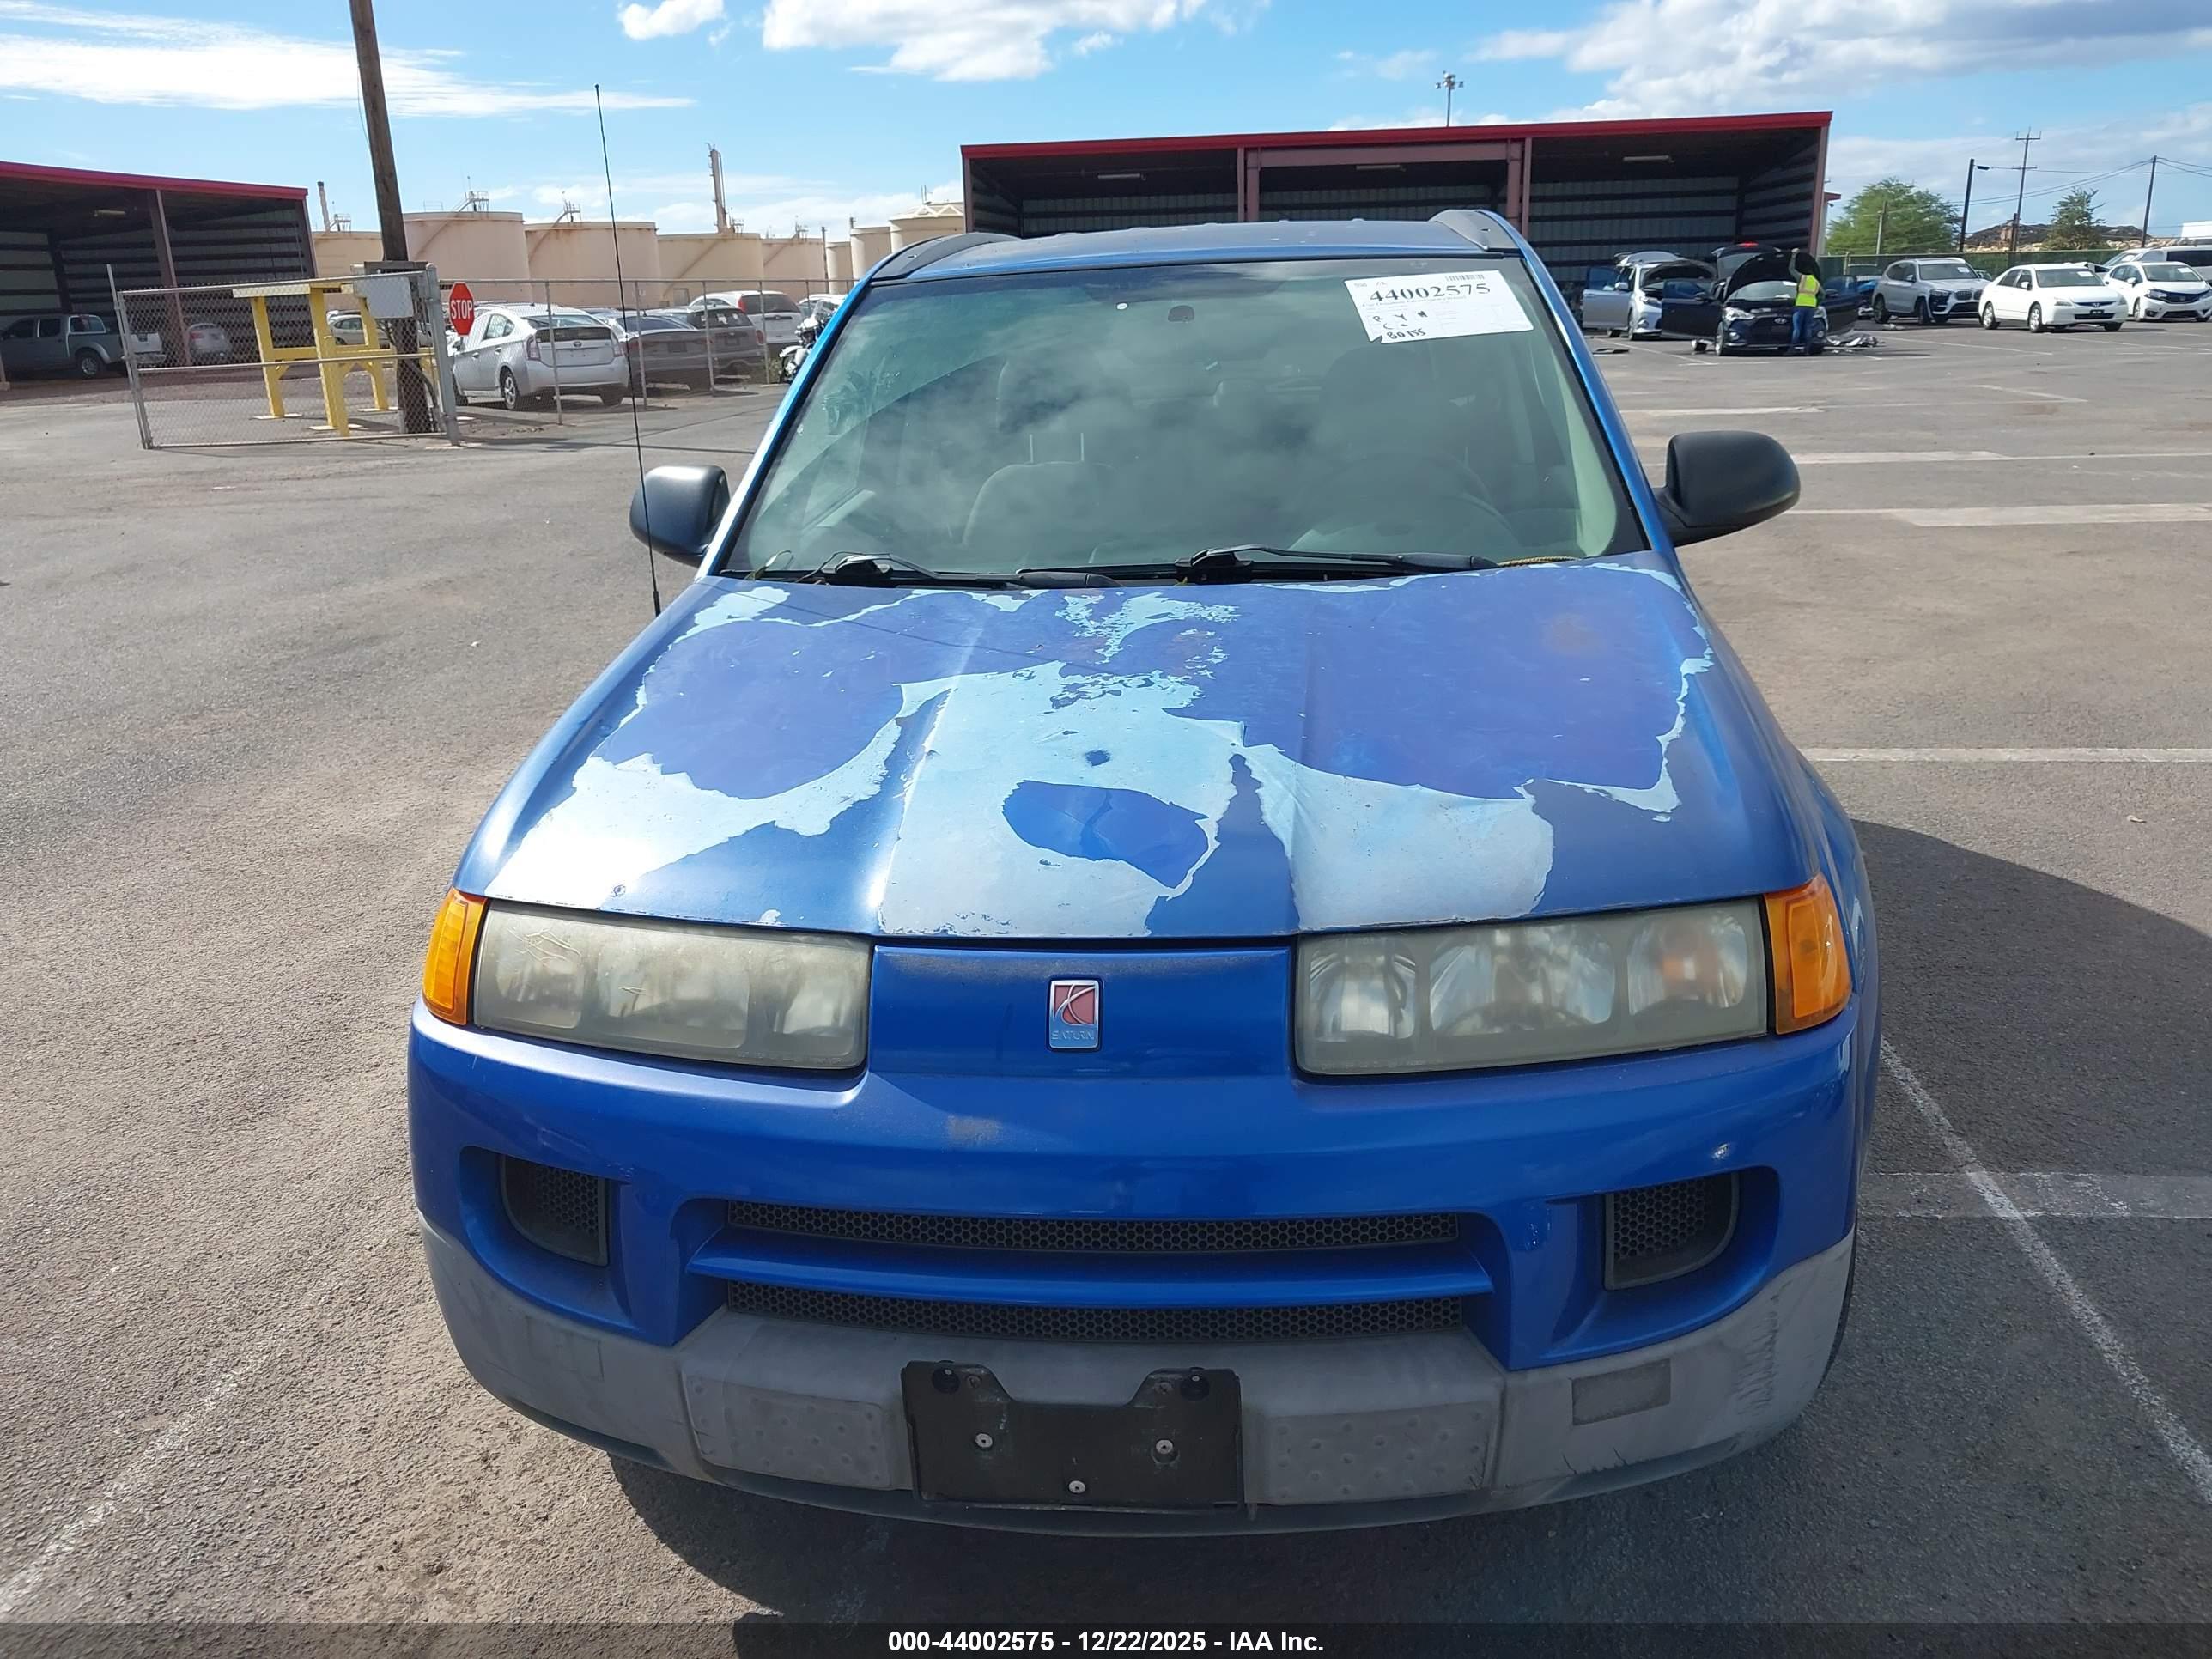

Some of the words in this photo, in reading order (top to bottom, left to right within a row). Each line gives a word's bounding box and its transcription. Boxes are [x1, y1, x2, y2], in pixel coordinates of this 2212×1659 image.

[1370, 283, 1491, 301] 44002575
[451, 300, 473, 319] STOP
[1051, 1030, 1095, 1040] SATURN
